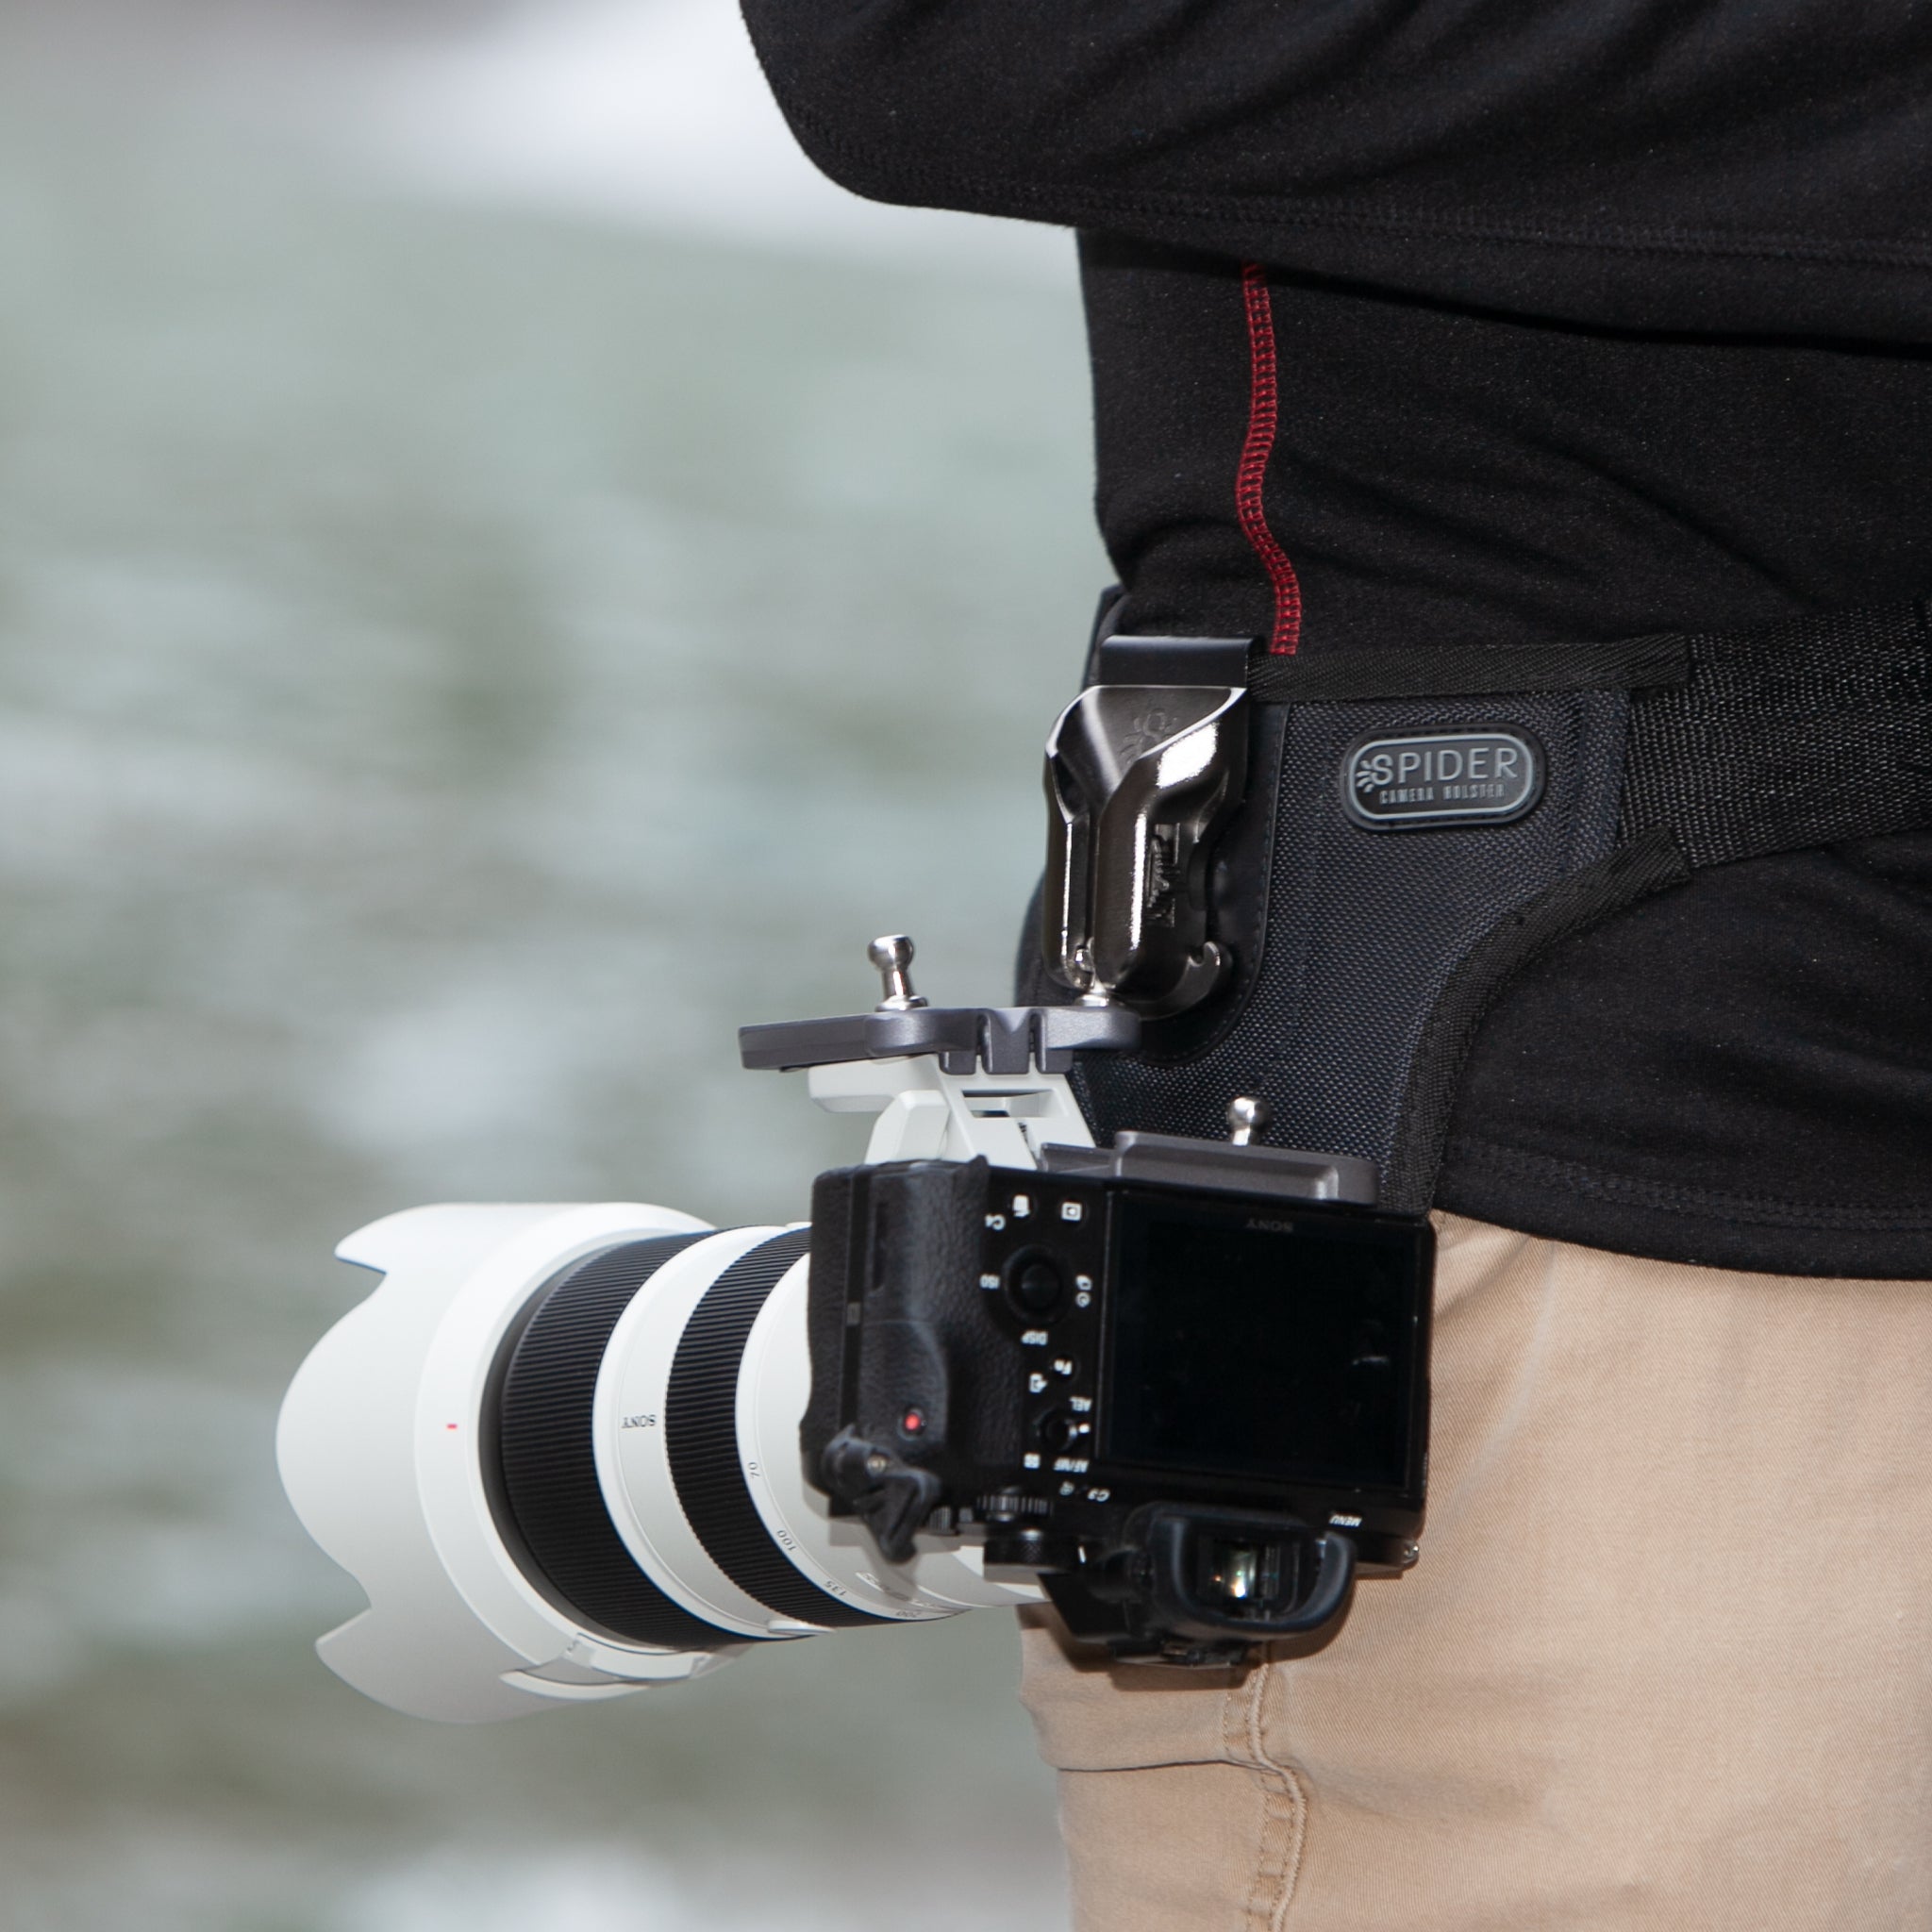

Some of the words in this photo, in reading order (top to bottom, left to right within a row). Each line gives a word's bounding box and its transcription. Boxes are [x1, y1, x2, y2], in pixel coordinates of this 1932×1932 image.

[1371, 746, 1518, 786] SPIDER
[1379, 786, 1435, 805] CAMERA
[1442, 783, 1505, 801] HOLSTER
[1246, 1218, 1293, 1233] SONY
[979, 1274, 1000, 1290] ISO
[1021, 1330, 1048, 1345] DISP
[1054, 1358, 1073, 1375] Fn
[1069, 1396, 1092, 1412] AEL
[621, 1414, 657, 1428] SONY
[747, 1461, 760, 1478] 70
[1329, 1514, 1362, 1527] MENU
[776, 1529, 797, 1552] 100
[824, 1579, 847, 1597] 135
